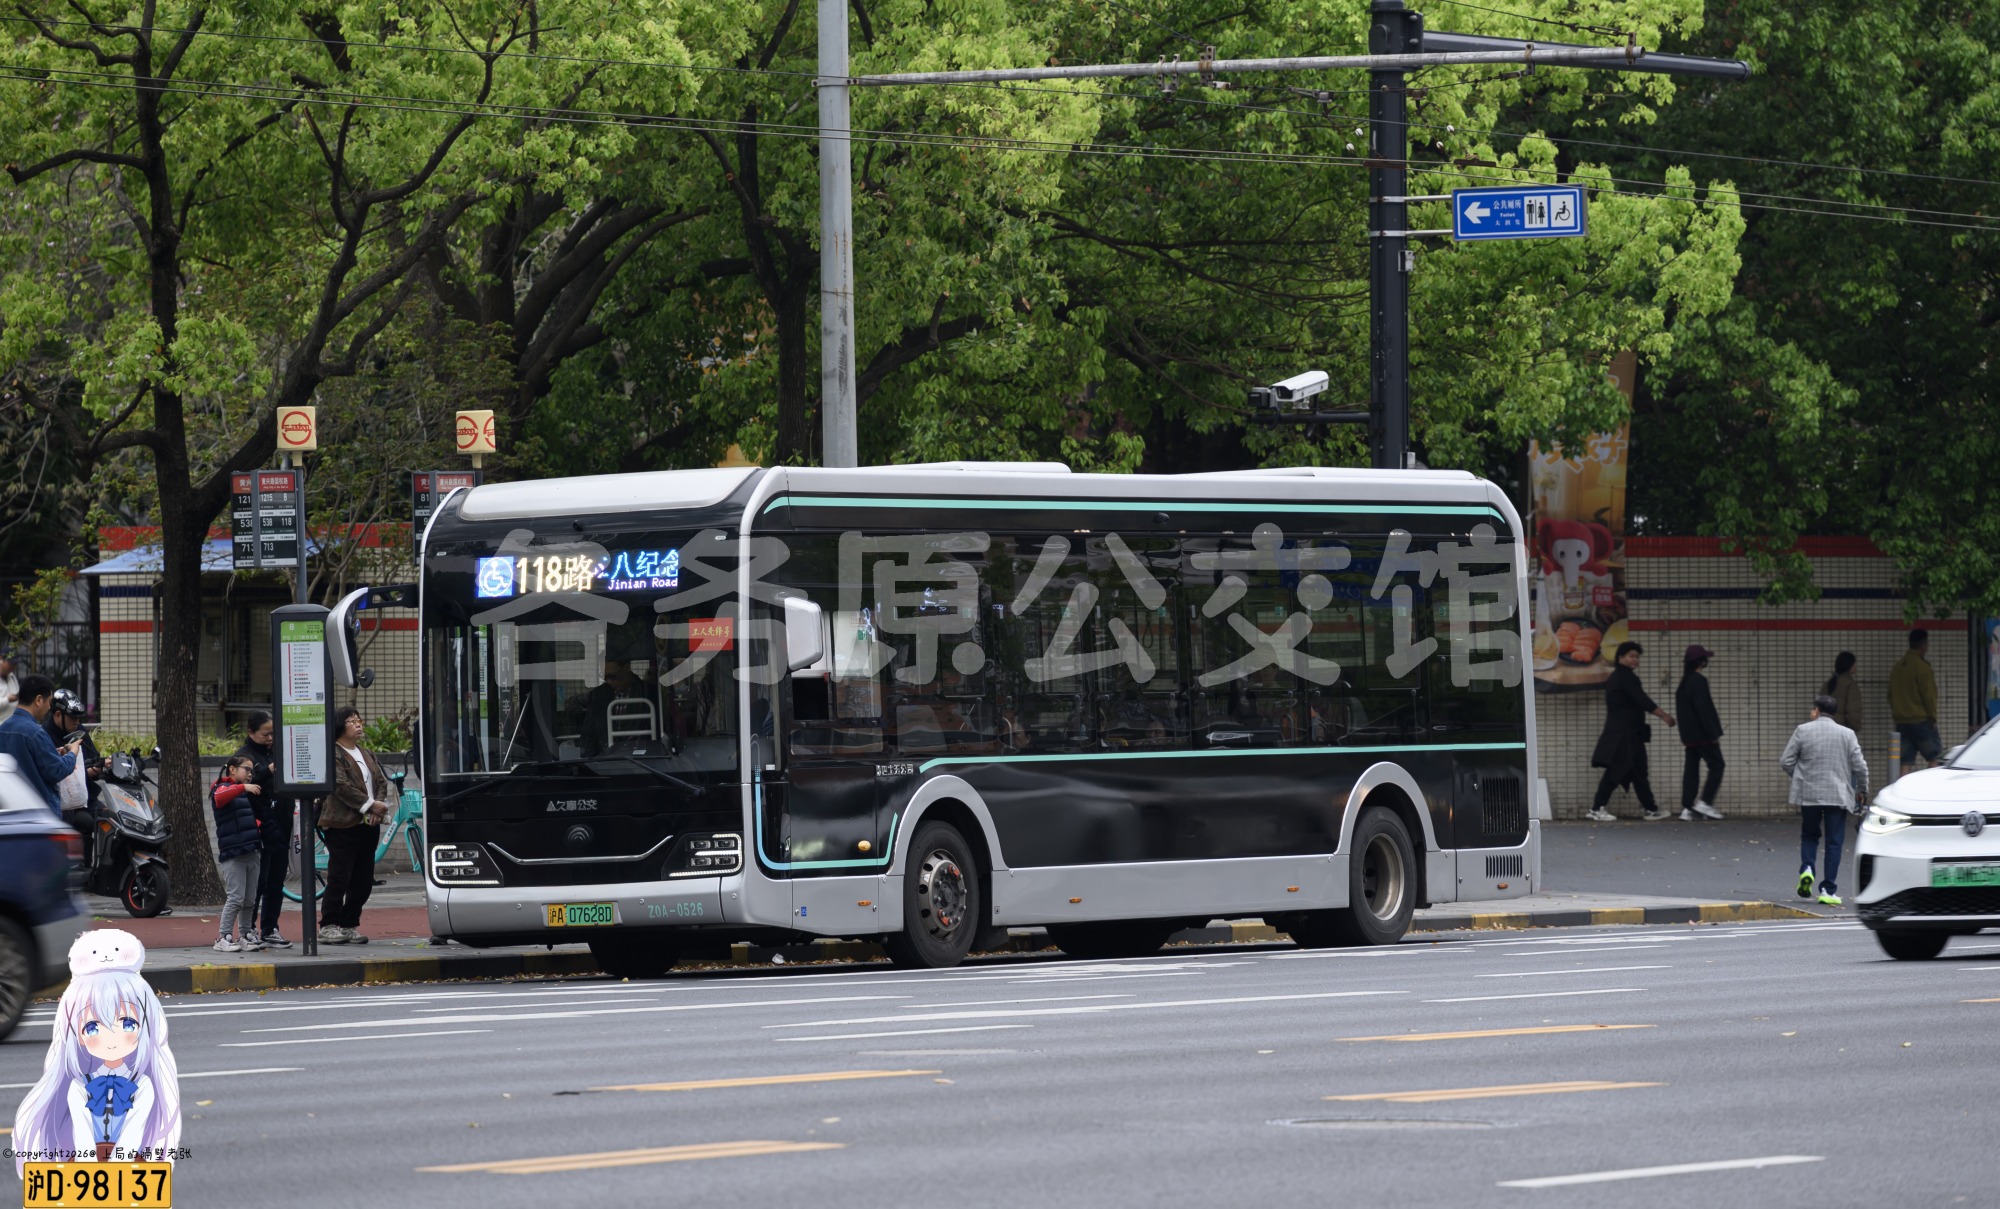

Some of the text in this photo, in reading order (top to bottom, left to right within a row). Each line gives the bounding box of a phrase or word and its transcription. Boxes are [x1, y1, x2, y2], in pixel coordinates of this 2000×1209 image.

[1493, 199, 1521, 210] 公共厕所
[260, 493, 273, 502] 1215
[283, 492, 288, 502] 8
[262, 517, 273, 527] 538
[281, 517, 292, 526] 118
[263, 542, 274, 551] 713
[516, 554, 593, 594] 118路
[608, 576, 679, 591] Jinian Road
[691, 625, 730, 638] 工人先锋号
[286, 705, 302, 714] 118
